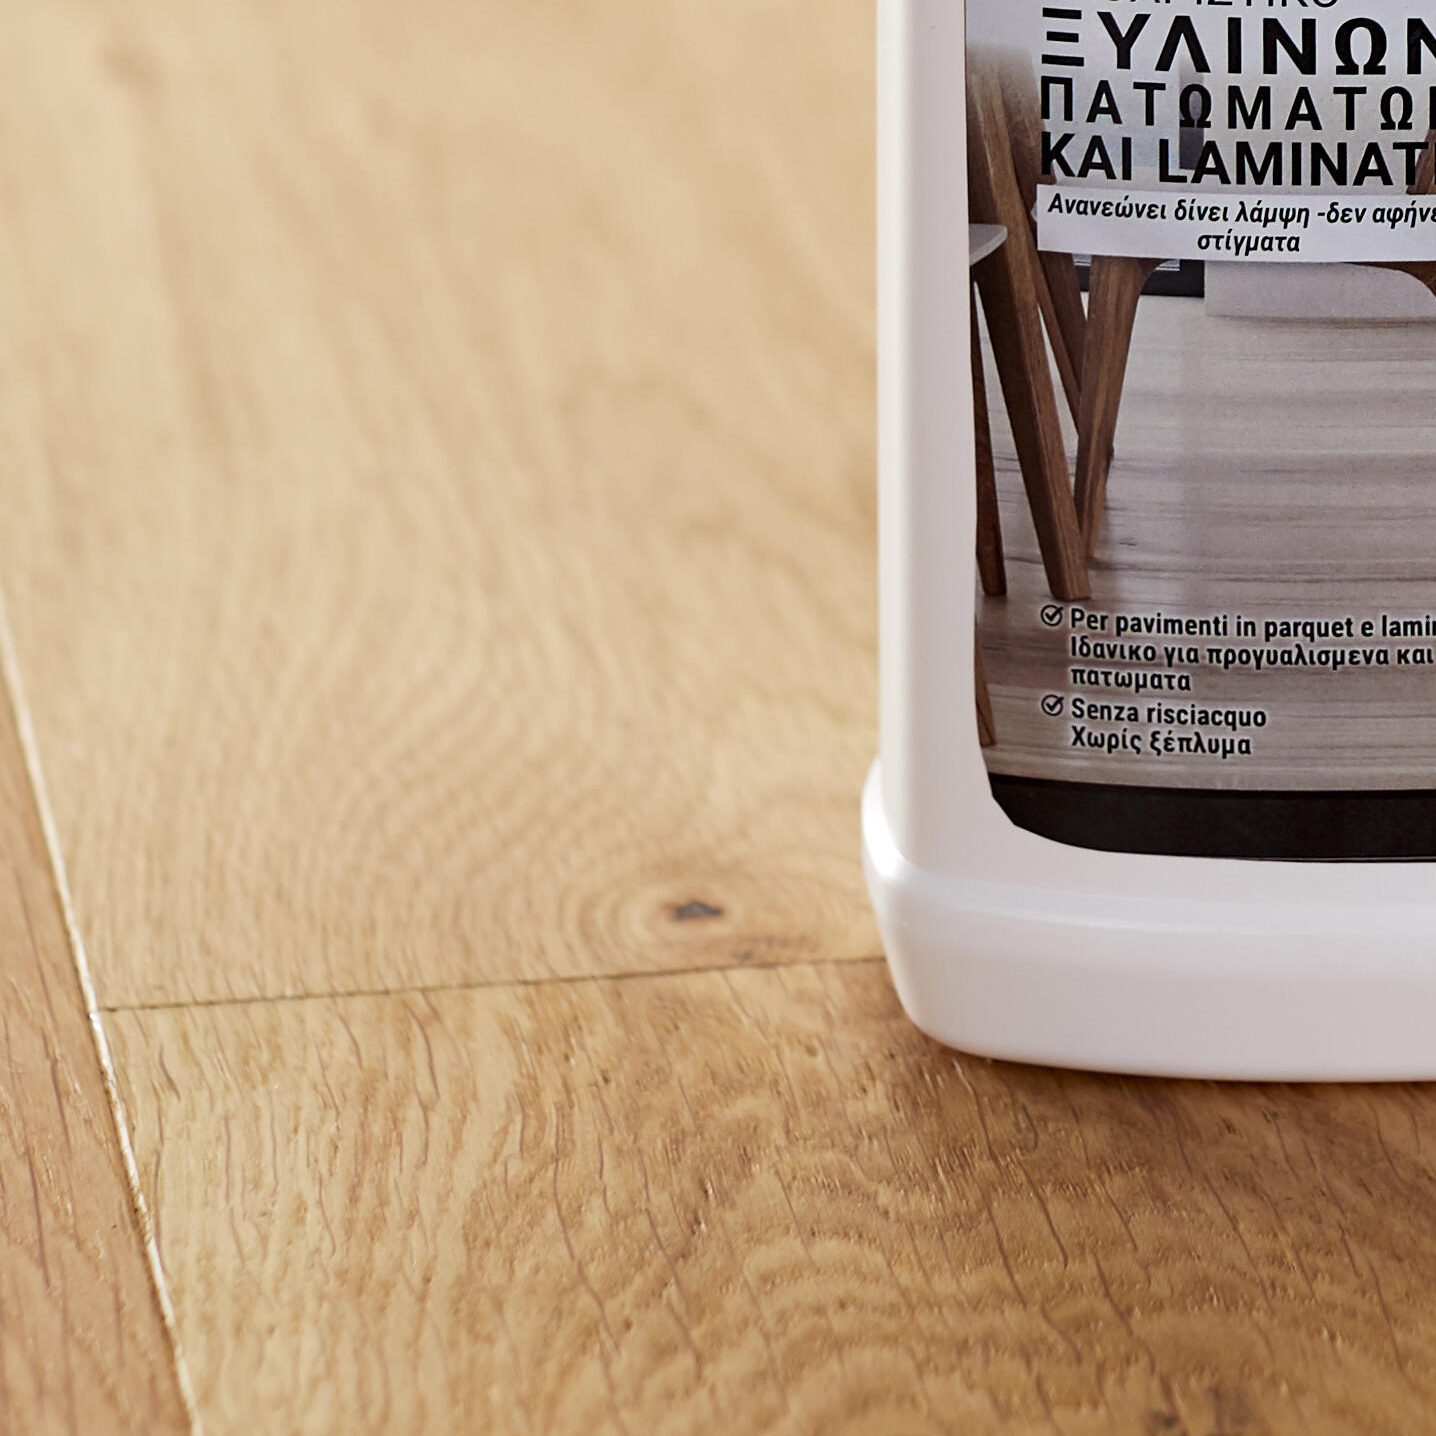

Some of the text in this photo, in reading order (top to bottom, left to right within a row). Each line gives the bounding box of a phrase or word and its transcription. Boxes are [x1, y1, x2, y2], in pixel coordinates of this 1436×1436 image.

[1048, 193, 1167, 220] Ανανεώνει
[1174, 198, 1229, 222] δίνει
[1235, 200, 1310, 230] λάμψη
[1197, 228, 1301, 257] στίγματα
[1071, 608, 1108, 631] Per
[1116, 613, 1228, 636] pavimenti
[1236, 615, 1256, 637] in
[1264, 618, 1354, 643] parquet
[1360, 620, 1374, 637] e
[1164, 647, 1199, 667] για
[1207, 644, 1389, 671] προγυαλισμενα
[1397, 648, 1433, 664] και
[1071, 668, 1191, 693] πατωματα
[1071, 697, 1267, 731] Senza risciacquo
[1072, 725, 1251, 759] Χωρίς ξέπλυμα
